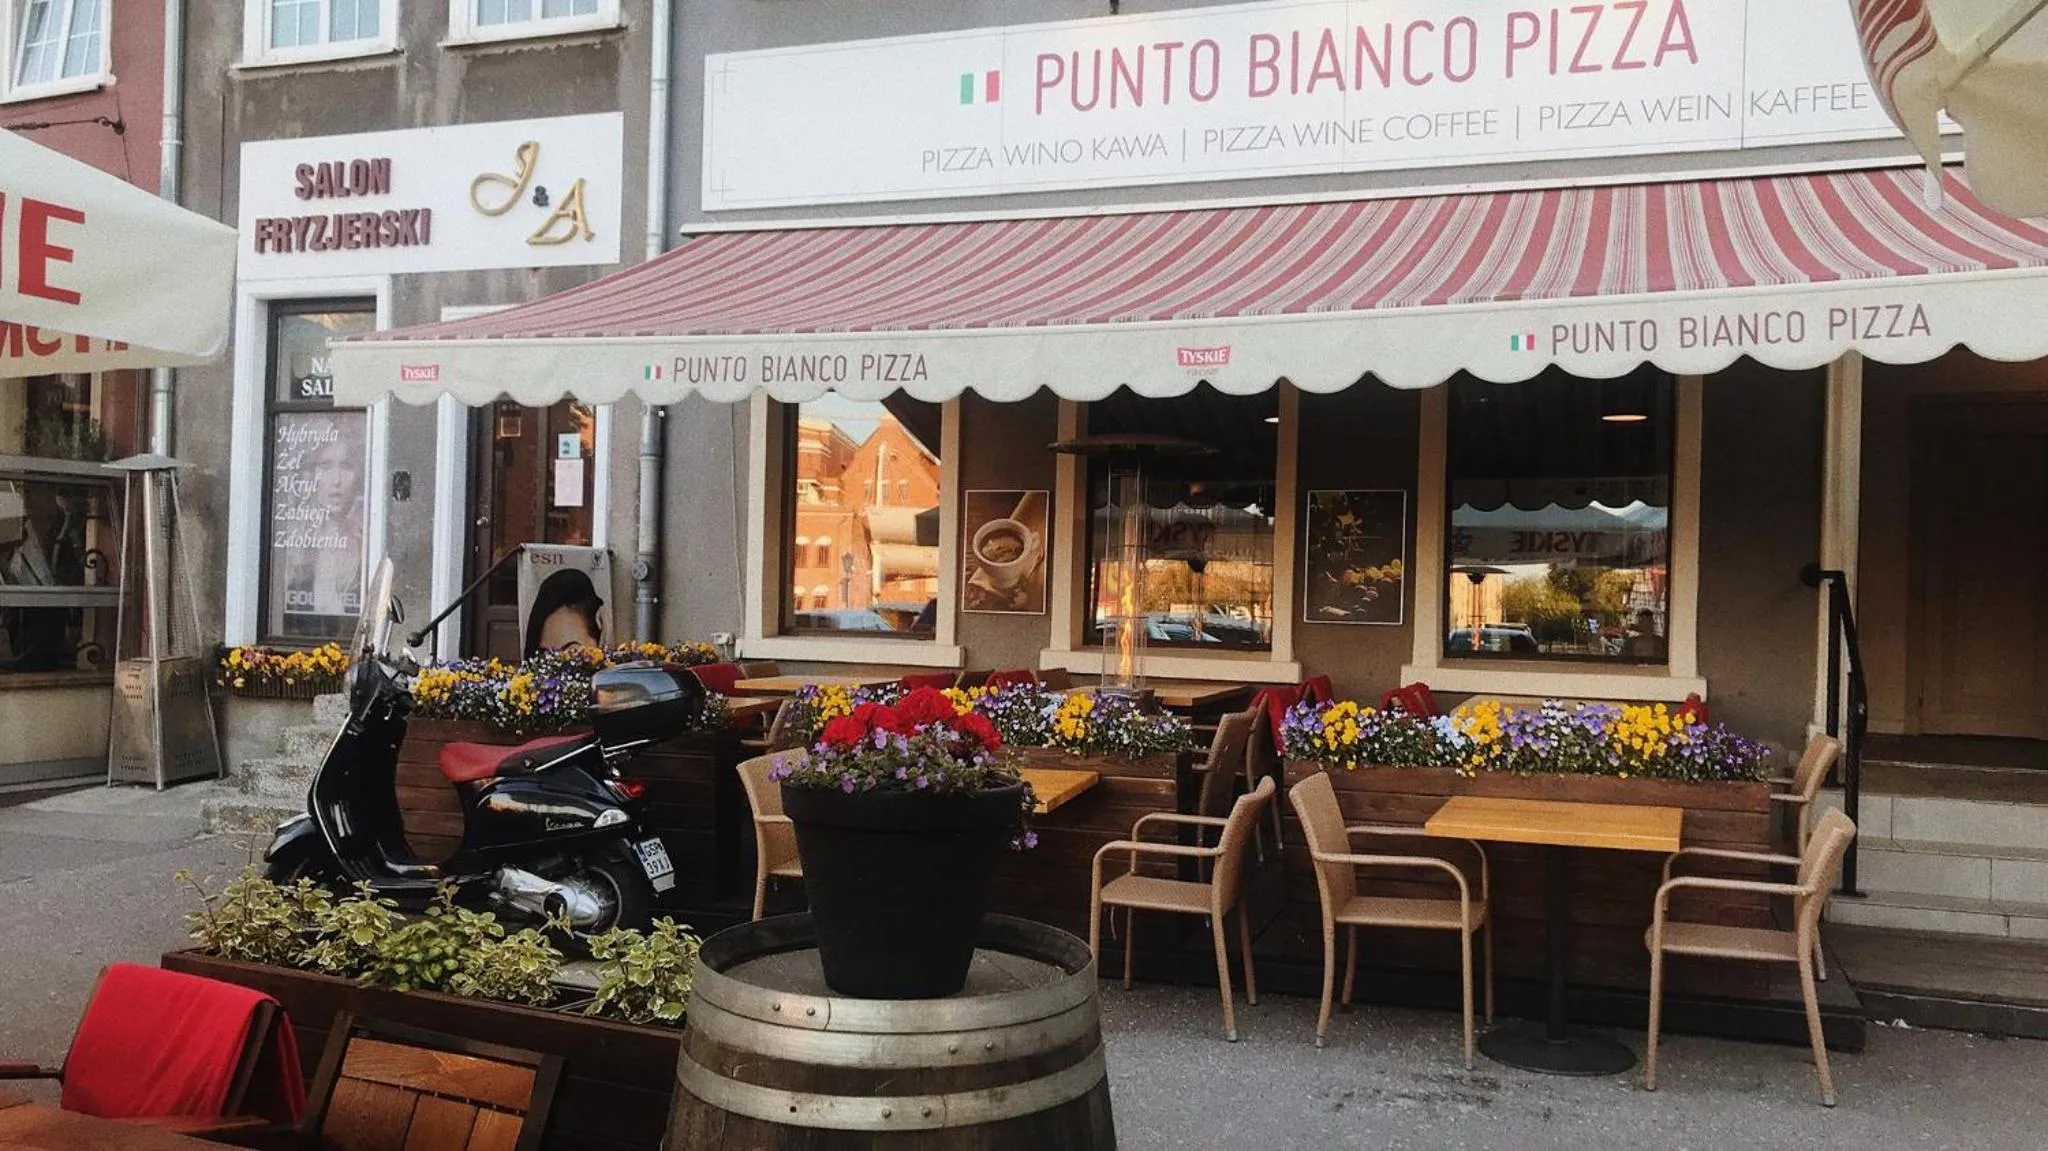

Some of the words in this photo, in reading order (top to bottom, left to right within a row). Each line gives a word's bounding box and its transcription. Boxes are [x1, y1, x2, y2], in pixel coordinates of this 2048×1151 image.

[1035, 38, 1221, 115] PUNTO
[1249, 16, 1478, 98] BIANCO
[1505, 0, 1699, 79] PIZZA
[922, 147, 994, 172] PIZZA
[1003, 139, 1084, 167] WINO
[1092, 133, 1169, 161] KAWA
[1203, 125, 1285, 153] PIZZA
[1293, 118, 1374, 147] WINE
[1383, 109, 1499, 142] COFFEE
[1540, 100, 1632, 131] PIZZA
[1641, 92, 1732, 125] WEIN
[1750, 82, 1869, 117] KAFFEE
[294, 157, 392, 201] SALON
[254, 207, 432, 255] FRYZJERSKI
[1552, 318, 1659, 356] PUNTO
[1679, 310, 1806, 350] BIANCO
[1829, 304, 1933, 341] PIZZA
[672, 356, 748, 384] PUNTO
[761, 354, 848, 383] BIANCO
[860, 353, 929, 382] PIZZA
[1180, 347, 1228, 365] TYSKIE
[277, 422, 339, 451] Hybryda
[275, 472, 322, 500] Akryl
[274, 528, 349, 550] Zdobienia
